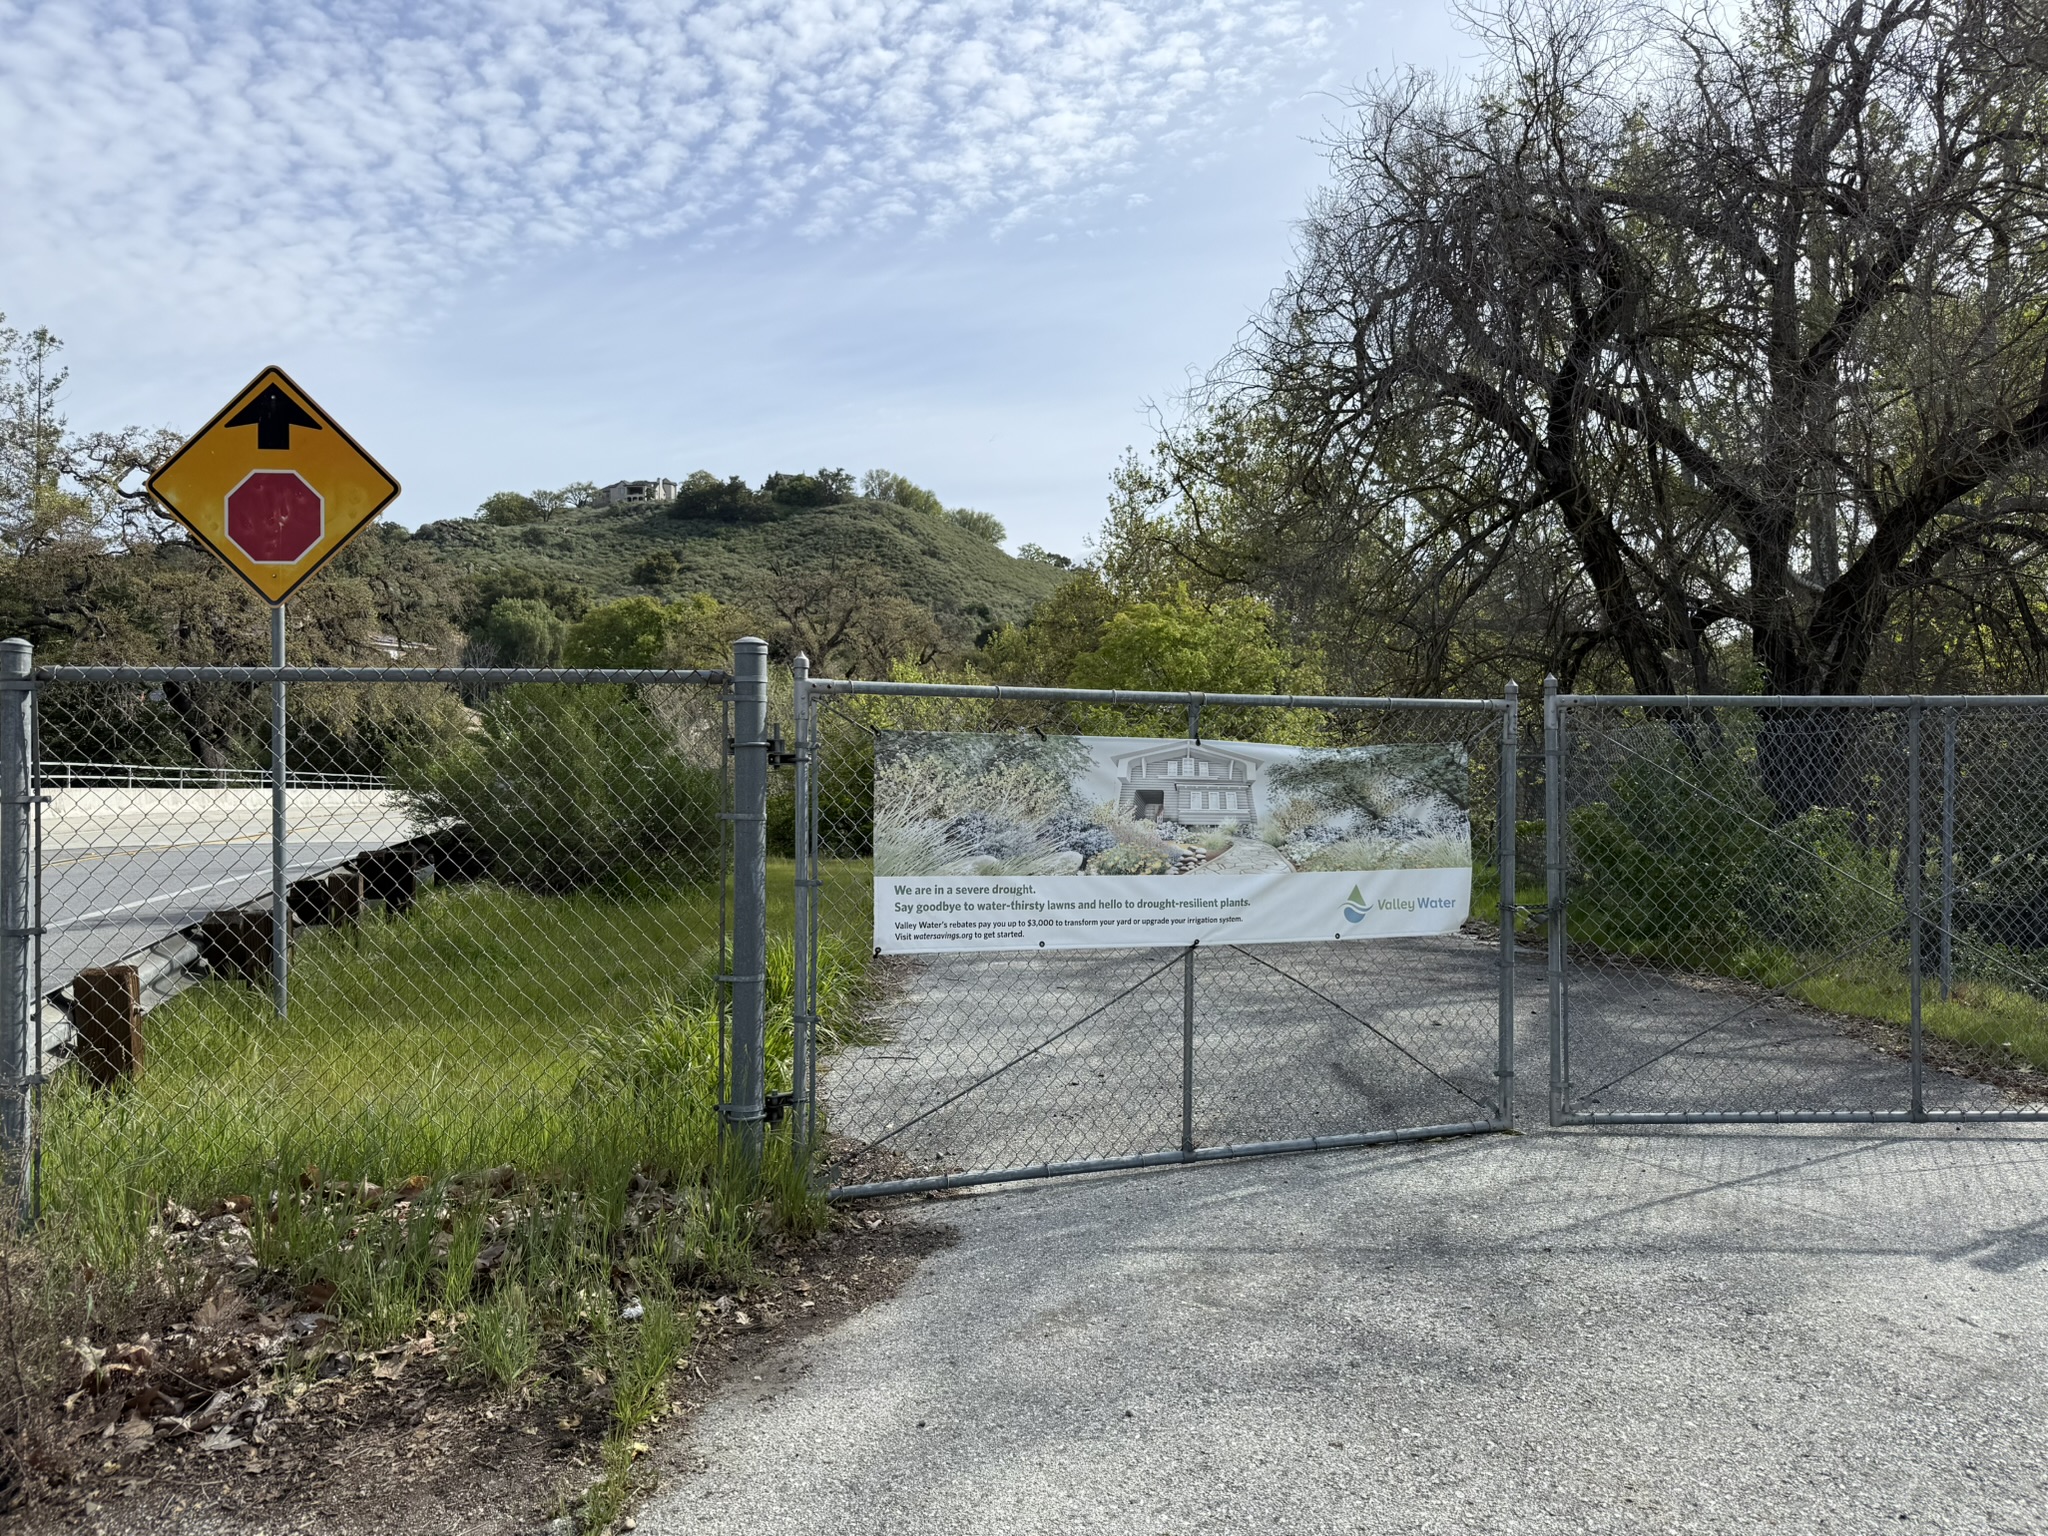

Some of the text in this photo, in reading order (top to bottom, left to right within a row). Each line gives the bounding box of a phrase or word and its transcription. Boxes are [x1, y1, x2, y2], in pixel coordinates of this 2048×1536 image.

[894, 884, 1036, 896] We are in a severe drought.
[894, 897, 1251, 915] Say goodbye to water-thirsty lawns and hello to drought-resilient plants.
[1377, 897, 1456, 912] Valley Water
[894, 921, 917, 931] Valley
[918, 921, 948, 929] Water's
[949, 920, 977, 929] rebates
[978, 921, 992, 929] pay
[992, 921, 1006, 929] you
[1007, 921, 1017, 929] up
[1027, 919, 1054, 928] $3,000
[1055, 919, 1063, 927] to
[1064, 918, 1099, 927] transform
[1099, 919, 1115, 927] your
[1116, 917, 1132, 927] yard
[1141, 916, 1169, 926] upgrade
[1170, 918, 1186, 926] your
[1187, 916, 1218, 925] irrigation
[1219, 916, 1243, 925] system.
[894, 930, 1025, 941] Visit watersavings.org to get started.
